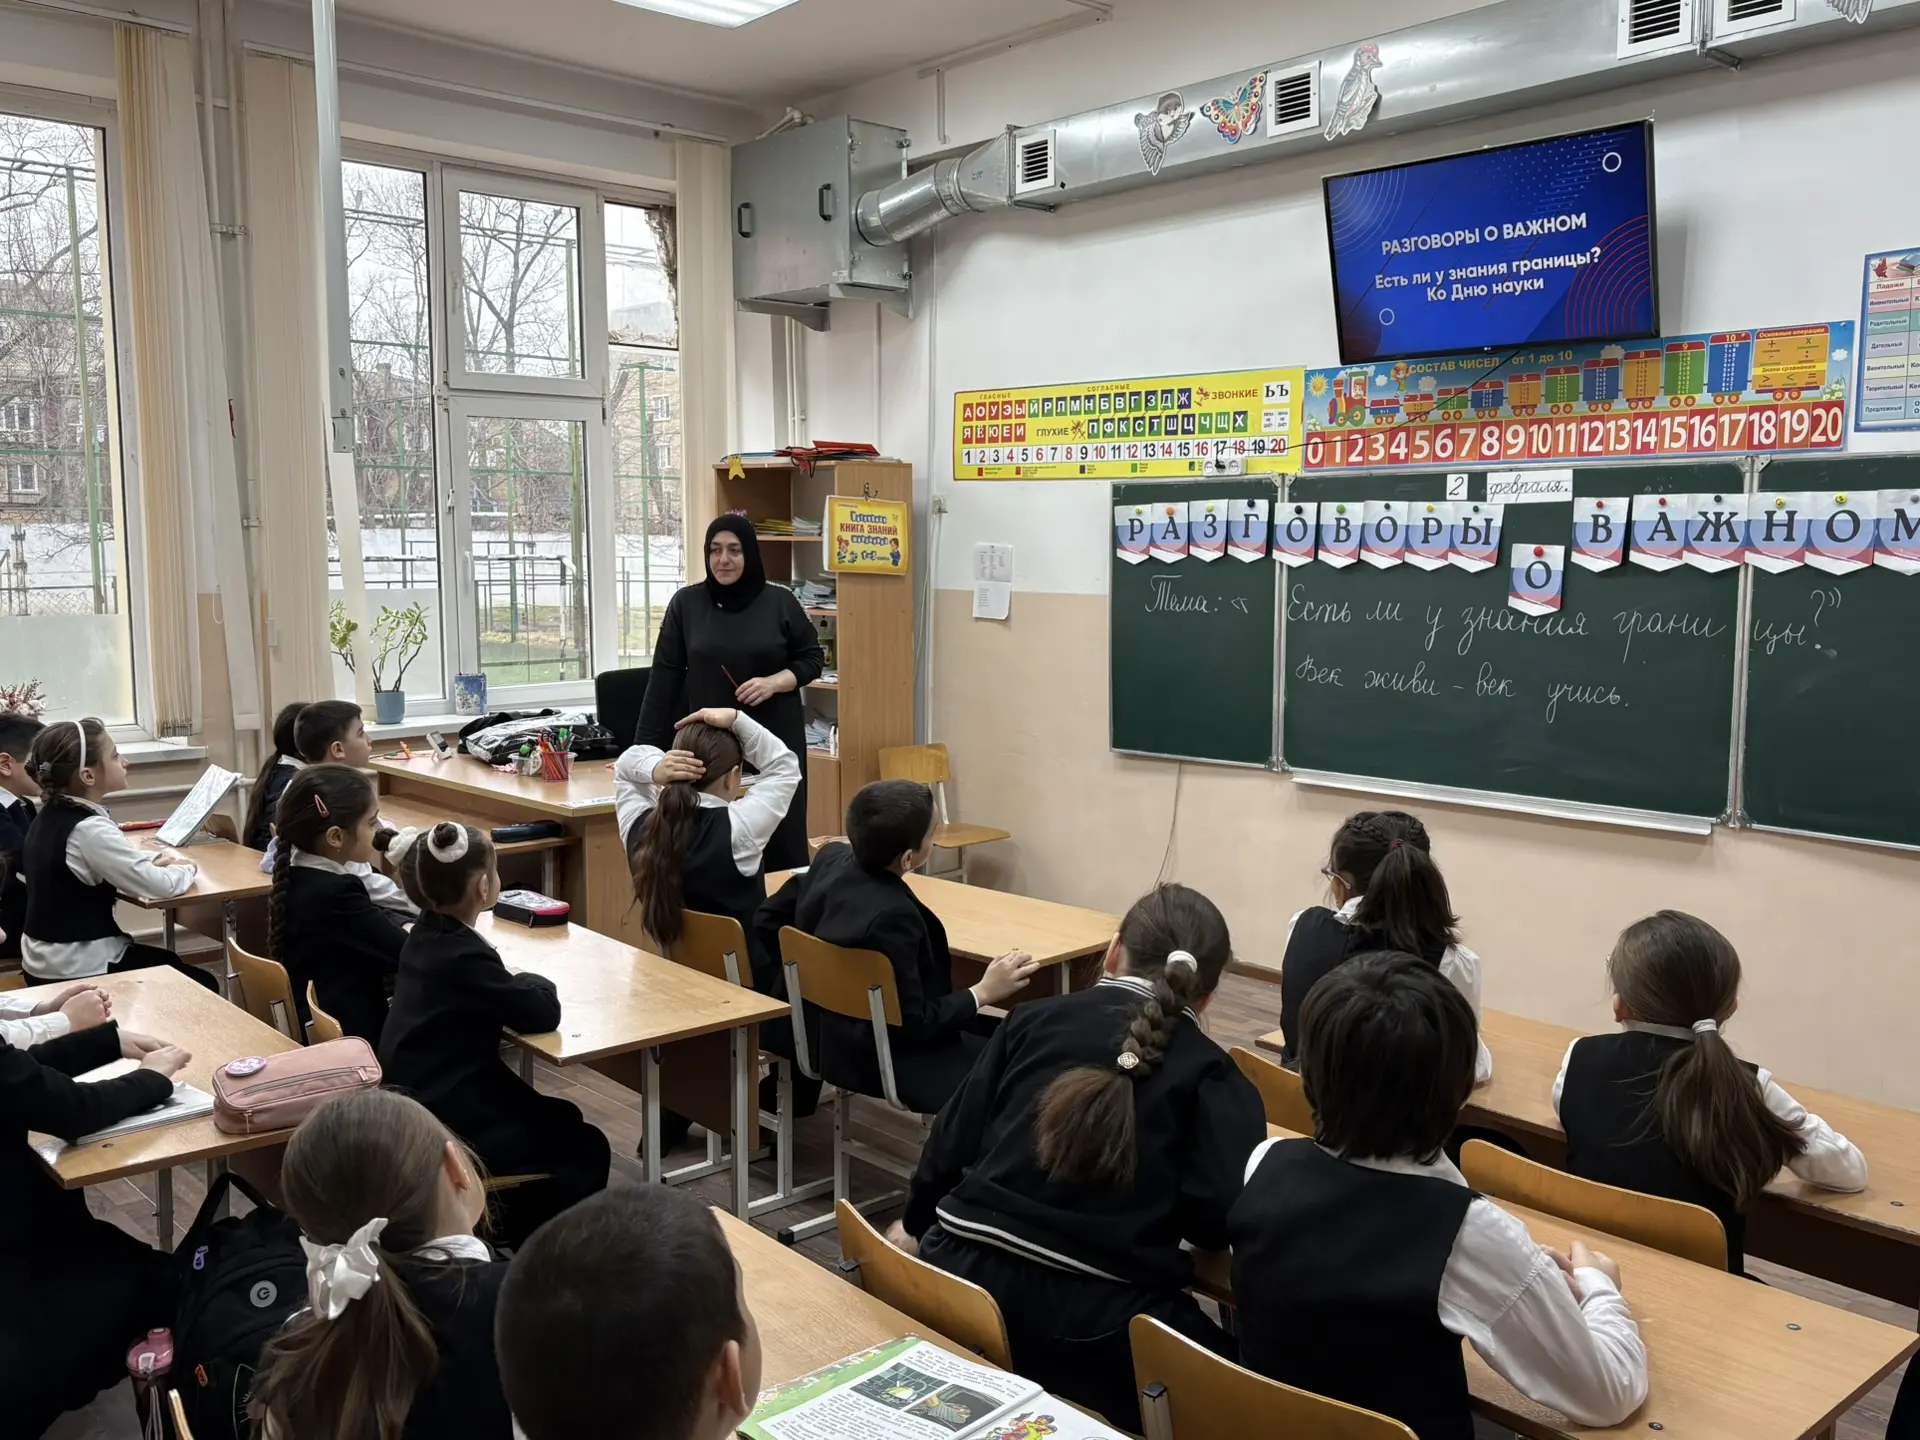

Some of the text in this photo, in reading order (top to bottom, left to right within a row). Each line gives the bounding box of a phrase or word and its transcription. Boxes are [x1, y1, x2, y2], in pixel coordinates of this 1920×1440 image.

[1381, 213, 1587, 256] РАЗГОВОРЫ О ВАЖНОМ
[1375, 246, 1601, 289] Есть ли у знания границы?
[1427, 277, 1544, 301] Ко Дню науки
[1726, 334, 1736, 342] 10
[1409, 350, 1572, 374] СОСТАВ ЧИСЕЛ от 1 до 10
[1087, 384, 1130, 392] СОГЛАСНЫЕ
[964, 384, 1289, 418] А О У Э Ы Й Р Л М Н Б В Г З Д Ж ЗВОНКИЕ Ь Ъ
[964, 414, 1244, 438] Я Ё Ю Е И ГЛУХИЕ П Ф К С Т Ш Ц Ч Щ Х
[1307, 408, 1842, 464] 0 1 2 3 4 5 6 7 8 9 10 11 12 13 14 15 16 17 18 19 20
[965, 438, 1286, 463] 1 2 3 4 5 6 7 8 9 10 11 12 13 14 15 16 17 18 19 20
[1450, 477, 1465, 496] 2
[840, 523, 897, 536] КНИГА ЗНАНИЙ
[1128, 508, 1920, 589] РАЗГОВОРЫ О ВАЖНОМ
[1145, 575, 1221, 613] Тема:
[1287, 583, 1352, 622] Есть
[1366, 599, 1405, 621] ли
[1426, 604, 1445, 651] у
[1457, 608, 1590, 655] знания
[1296, 654, 1344, 688] Век
[1364, 662, 1441, 697] живи
[1476, 661, 1516, 697] век
